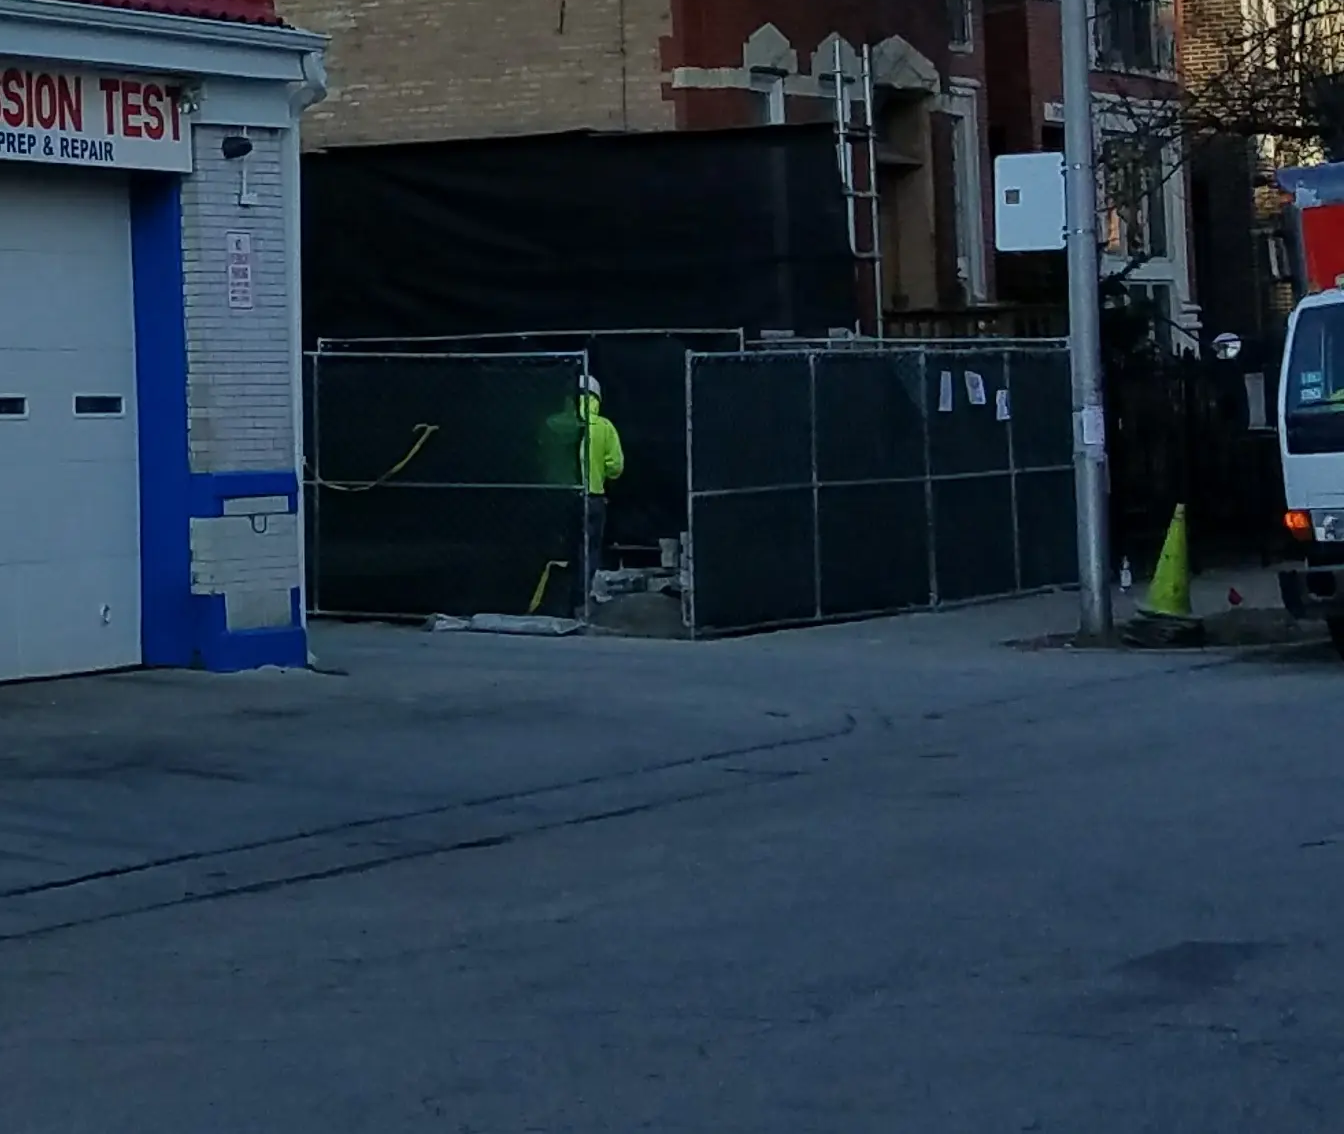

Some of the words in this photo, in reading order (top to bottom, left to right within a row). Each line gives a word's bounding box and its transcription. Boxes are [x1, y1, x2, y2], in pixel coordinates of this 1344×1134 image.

[100, 78, 181, 141] TEST
[43, 136, 54, 156] &
[60, 137, 114, 162] REPAIR
